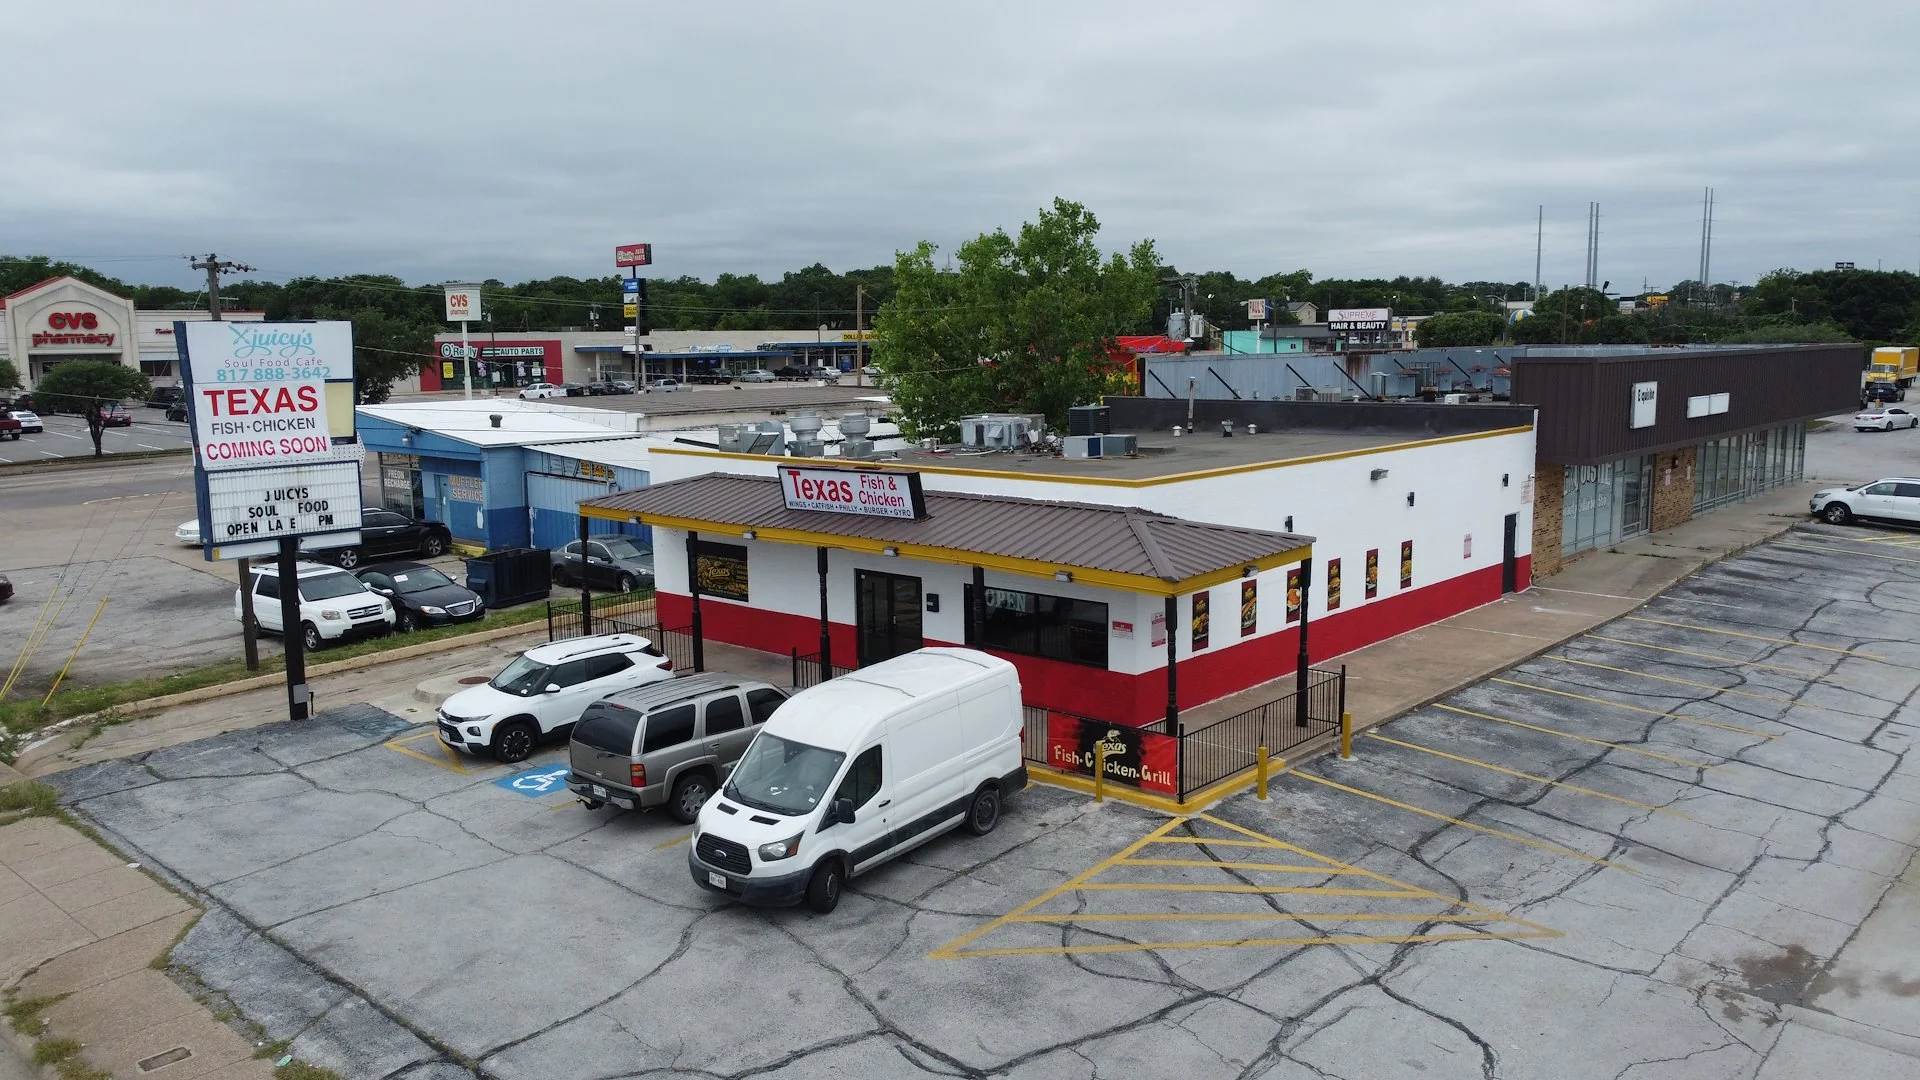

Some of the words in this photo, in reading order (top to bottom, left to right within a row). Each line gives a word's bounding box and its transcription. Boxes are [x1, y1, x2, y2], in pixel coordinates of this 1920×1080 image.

[450, 294, 468, 308] CVS
[48, 312, 98, 330] CVS
[1338, 310, 1377, 321] SUPREME
[1330, 322, 1348, 330] HAIR
[1357, 321, 1385, 330] BEAUTY
[32, 331, 115, 348] pharmacy
[234, 328, 316, 358] juicy's
[500, 347, 519, 355] AUTO
[521, 347, 543, 355] PARTS
[225, 359, 253, 368] Soul
[260, 358, 290, 367] Food
[296, 357, 323, 366] Cafe
[217, 368, 249, 382] 817
[254, 366, 331, 381] 888-3642
[203, 385, 319, 417] TEXAS
[206, 439, 275, 461] COMING
[280, 436, 327, 455] SOON
[387, 469, 405, 480] FREON
[448, 475, 483, 489] MUFFLER
[860, 474, 885, 490] Fish
[888, 476, 897, 491] &
[384, 478, 411, 490] RECHARGE
[787, 470, 853, 503] Texas
[452, 488, 484, 502] SERVICE
[858, 490, 905, 507] Chicken
[248, 505, 279, 519] SOUL
[298, 500, 329, 514] FOOD
[811, 502, 834, 510] CATFISH
[839, 504, 858, 512] PHILLY
[864, 507, 889, 515] BURGER
[893, 509, 912, 517] GYRO
[227, 521, 258, 536] OPEN
[318, 515, 333, 526] PM
[985, 588, 1027, 612] OPEN
[1141, 764, 1171, 786] Grill
